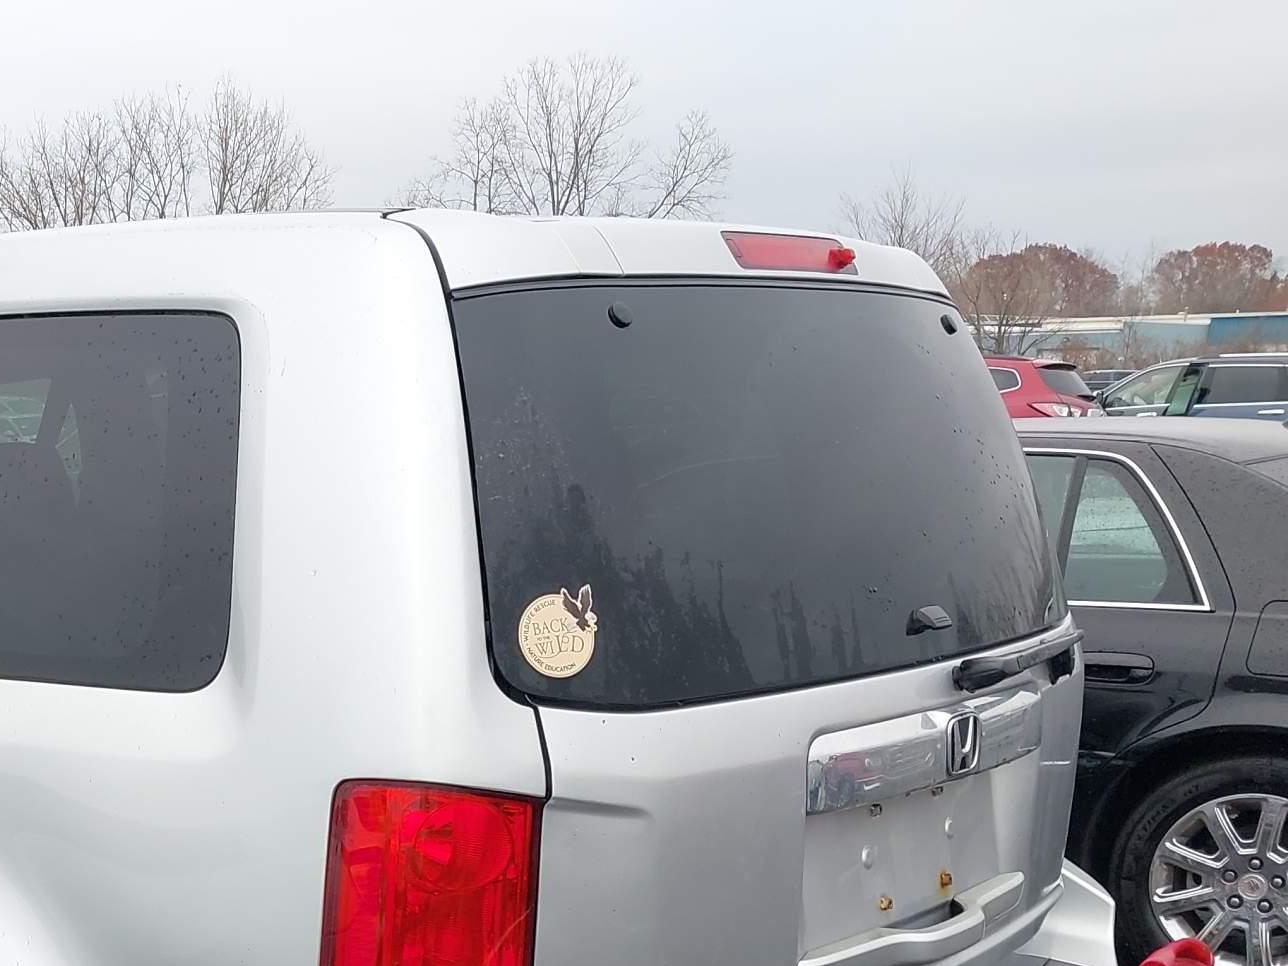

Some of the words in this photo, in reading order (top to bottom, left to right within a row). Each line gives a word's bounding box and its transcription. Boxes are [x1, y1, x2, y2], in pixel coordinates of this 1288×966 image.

[523, 610, 536, 642] WILDLIFE
[533, 599, 556, 612] RESCUE
[531, 617, 569, 636] BACK
[534, 634, 584, 655] WILD
[527, 647, 544, 667] NATURE
[544, 663, 576, 673] EDUCATION
